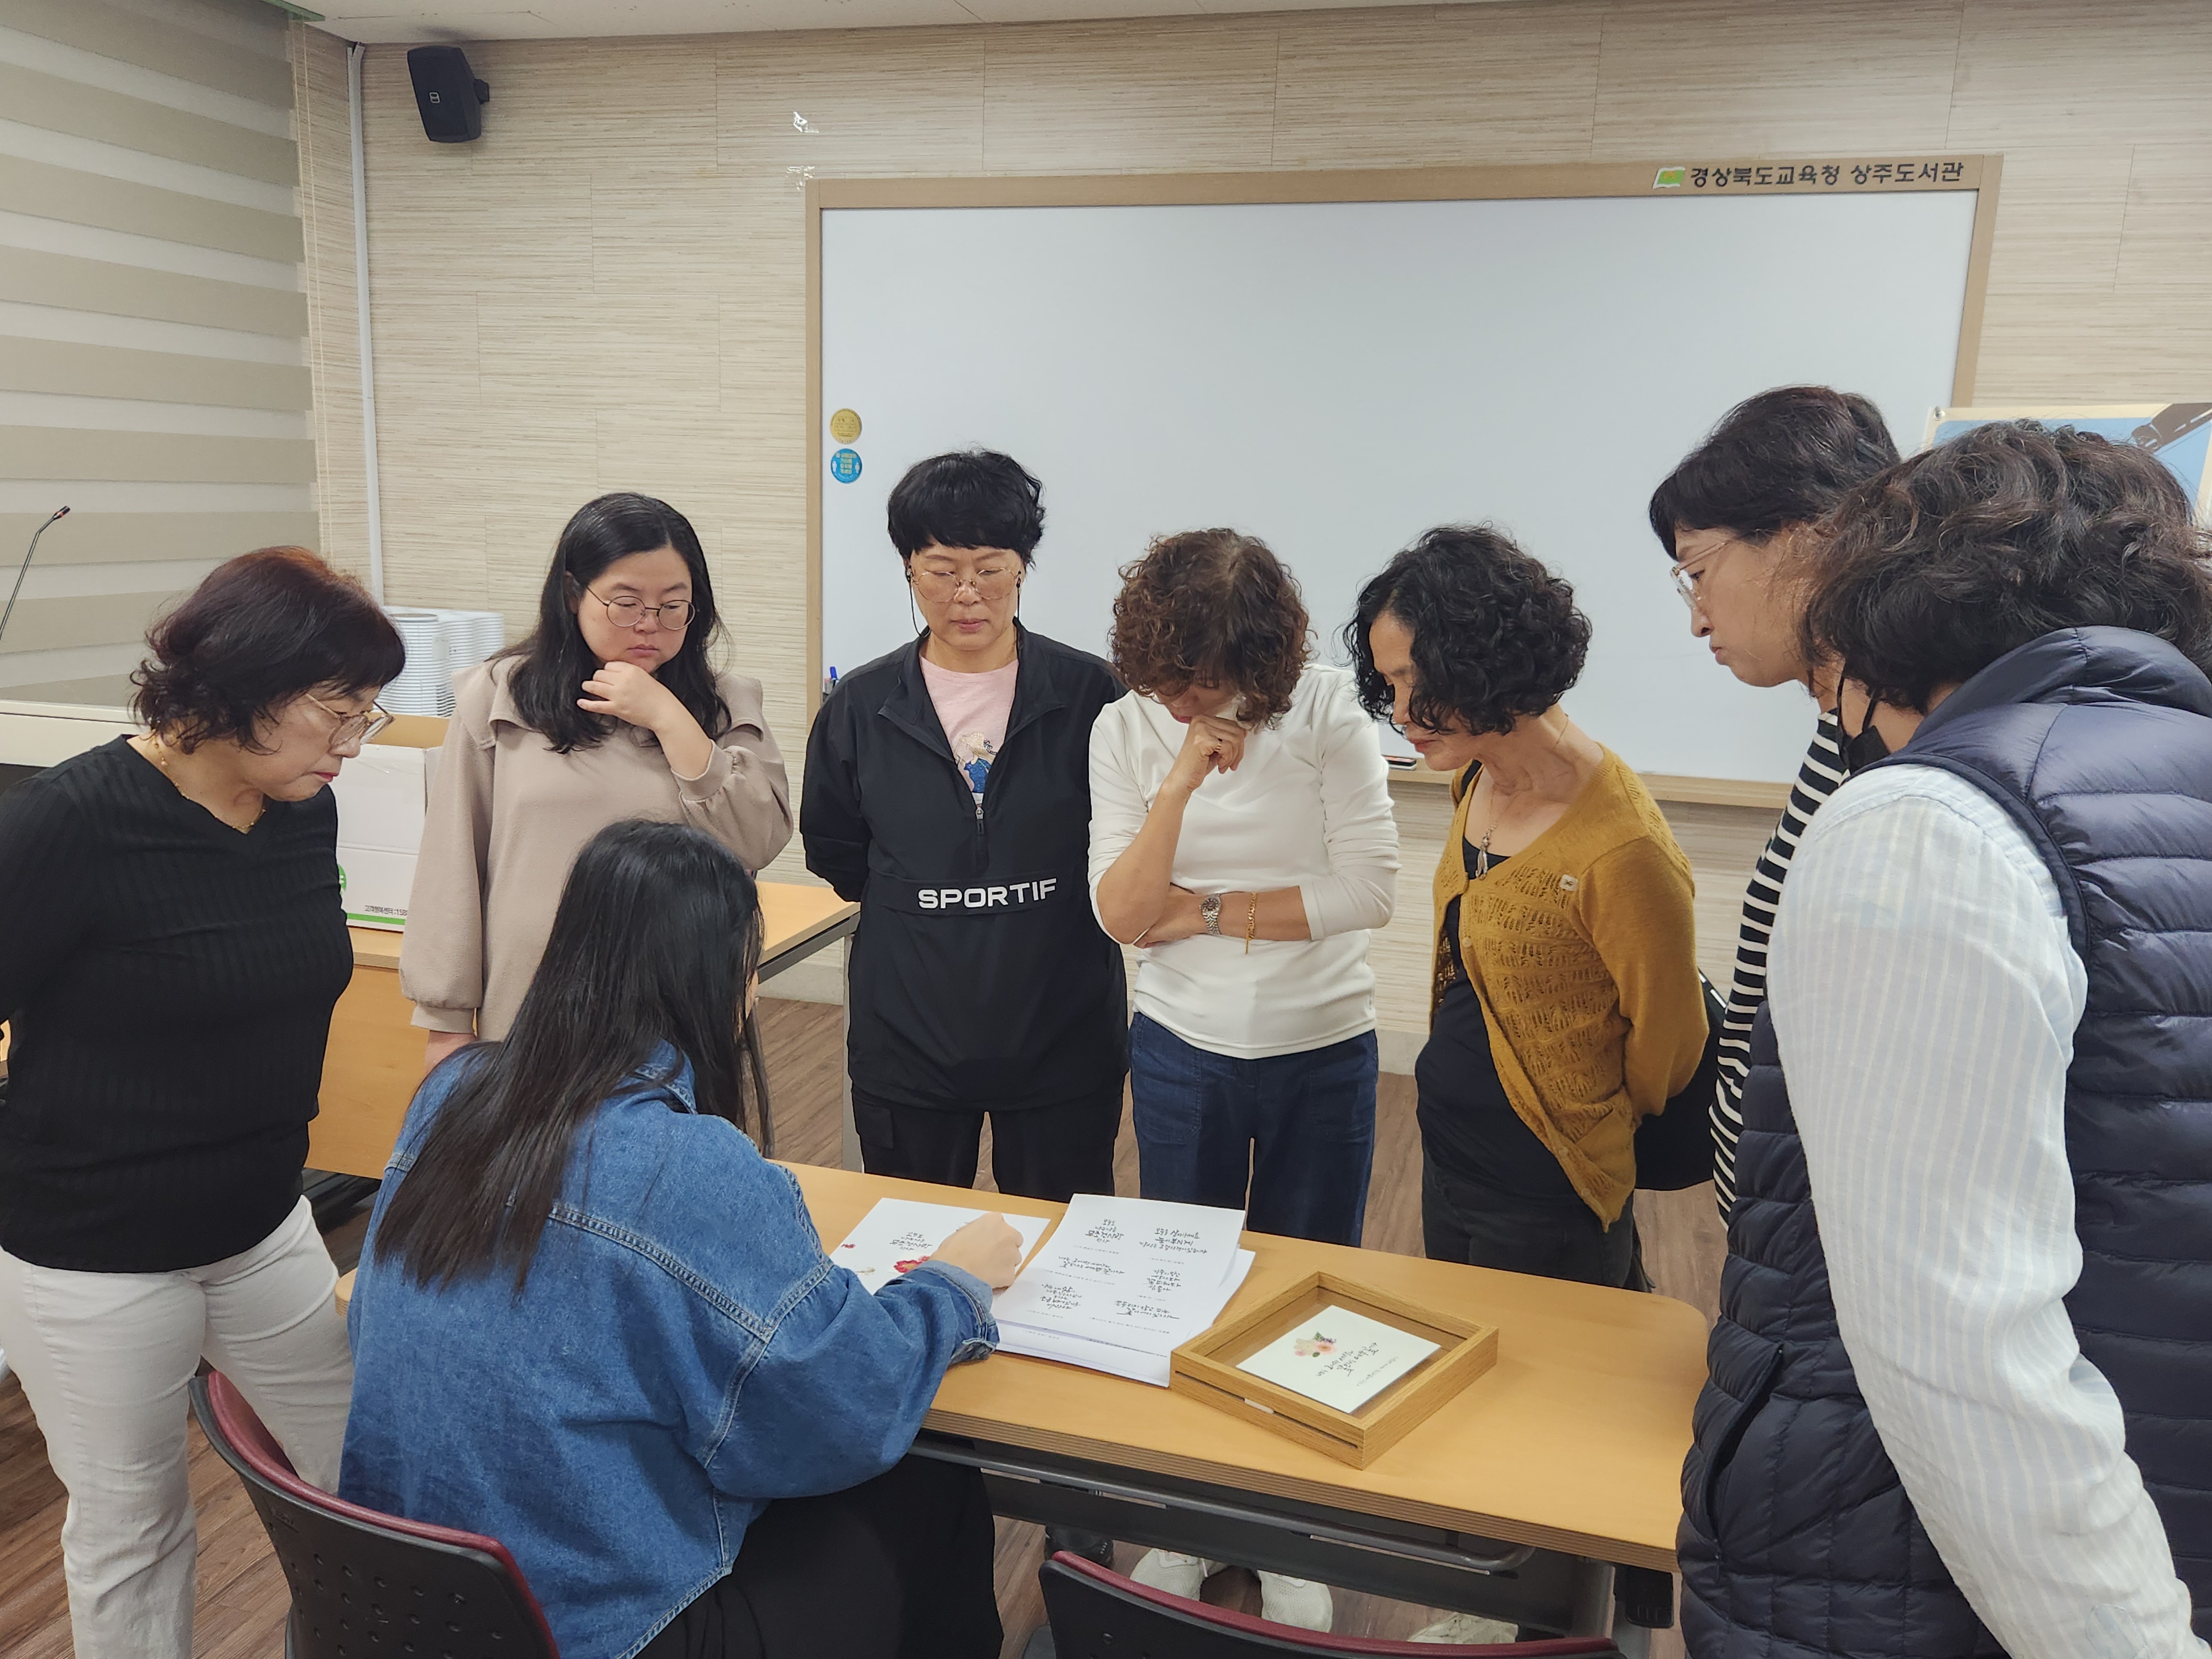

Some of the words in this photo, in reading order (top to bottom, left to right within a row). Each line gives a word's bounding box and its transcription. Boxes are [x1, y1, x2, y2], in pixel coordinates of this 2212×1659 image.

[1691, 165, 1841, 188] 경상북도교육청
[1850, 162, 1964, 185] 상주도서관
[918, 878, 1057, 910] SPORTIF
